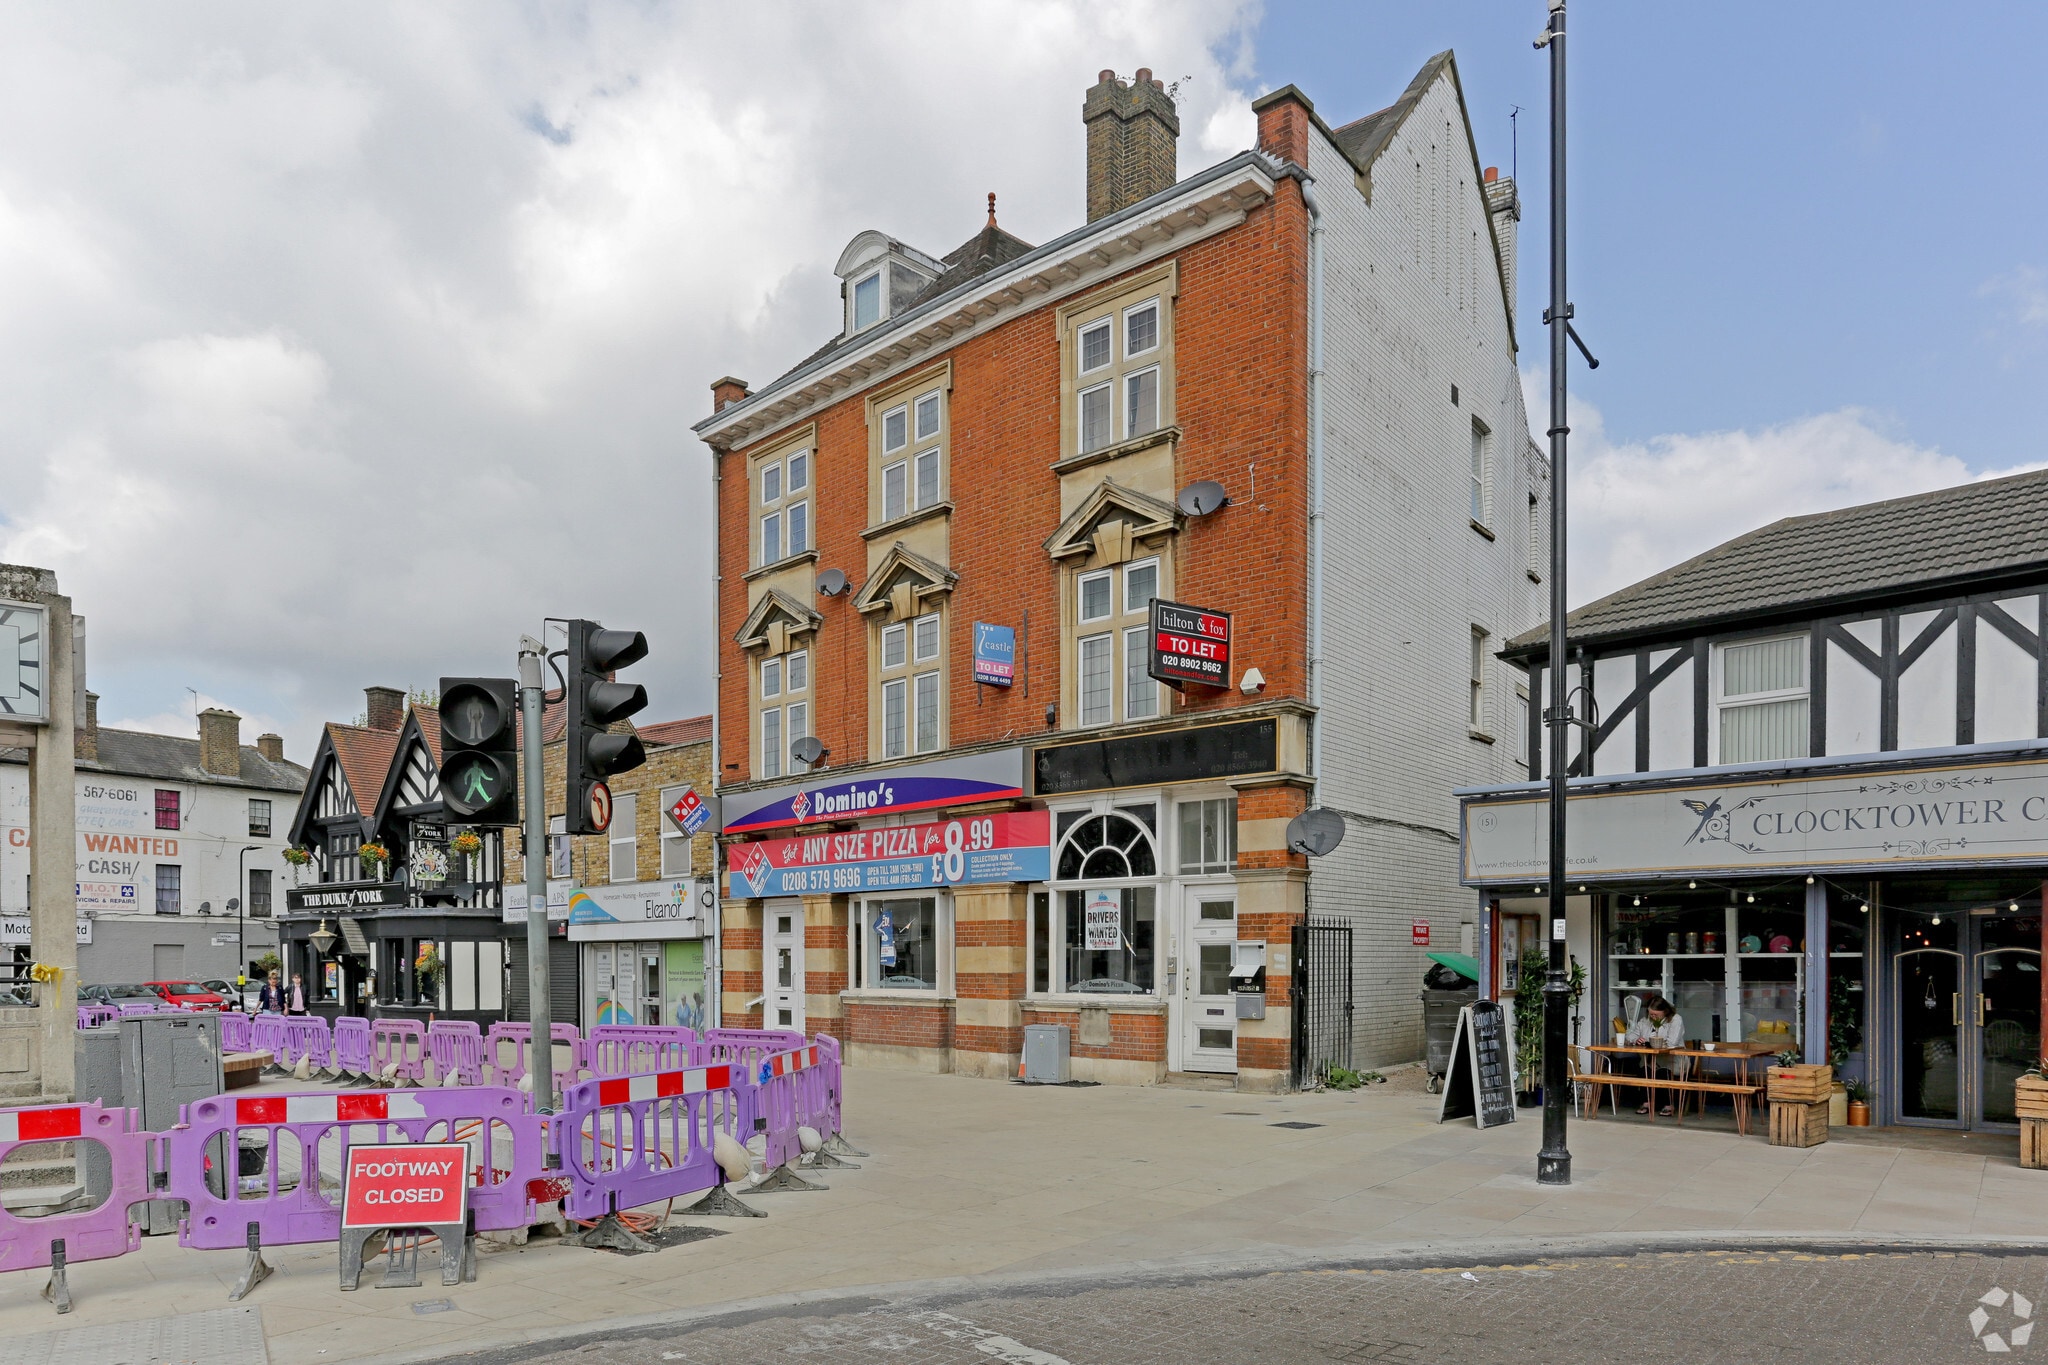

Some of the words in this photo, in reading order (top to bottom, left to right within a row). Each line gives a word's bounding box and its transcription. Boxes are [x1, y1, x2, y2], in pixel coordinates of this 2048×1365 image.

[1163, 611, 1194, 630] hilton
[1197, 617, 1206, 632] &
[1210, 620, 1224, 636] fox
[985, 641, 1012, 652] castle
[1170, 637, 1189, 653] TO
[1192, 641, 1217, 658] LET
[979, 662, 991, 672] TO
[993, 664, 1010, 675] LET
[1162, 655, 1178, 666] 020
[1180, 657, 1200, 670] 8902
[1202, 662, 1222, 673] 9662
[1164, 667, 1220, 682] hiltonandfox.com
[1260, 724, 1272, 733] 155
[1232, 751, 1248, 760] Tel:
[84, 785, 138, 801] 567-6061
[815, 782, 894, 815] Domino's
[80, 804, 139, 817] guarantee
[684, 806, 706, 828] Domino's
[1752, 798, 2008, 836] CLOCKTOWER
[76, 816, 104, 826] CTED
[109, 818, 135, 829] CARS
[688, 819, 703, 834] Pizza
[1481, 818, 1494, 827] 151
[84, 833, 178, 857] WANTED
[782, 843, 798, 864] Get
[803, 837, 829, 864] ANY
[834, 833, 866, 861] SIZE
[872, 827, 918, 858] PIZZA
[923, 826, 941, 854] for
[971, 855, 999, 863] COLLECTION
[1000, 853, 1014, 861] ONLY
[1478, 855, 1598, 869] www.theclocktowfe.co.uk
[867, 867, 879, 876] OPEN
[880, 865, 889, 875] TILL
[890, 864, 899, 874] 2AM
[900, 863, 924, 874] (SUN-THU)
[782, 872, 807, 892] 0208
[810, 869, 830, 890] 579
[833, 867, 861, 889] 9696
[867, 877, 879, 886] OPEN
[880, 875, 889, 885] TILL
[890, 875, 899, 885] 4AM
[900, 873, 922, 884] (FRI-SAT)
[83, 883, 118, 893] M.O.T
[302, 894, 320, 907] THE
[322, 893, 347, 906] DUKE
[346, 889, 358, 907] of
[357, 890, 383, 903] YORK
[510, 895, 528, 906] Feath
[552, 892, 565, 903] APS
[645, 899, 683, 919] Eleanor
[1087, 911, 1119, 924] DRIVERS
[76, 925, 88, 935] td
[1088, 927, 1118, 938] WANTED
[354, 1161, 453, 1178] FOOTWAY
[365, 1187, 444, 1205] CLOSED
